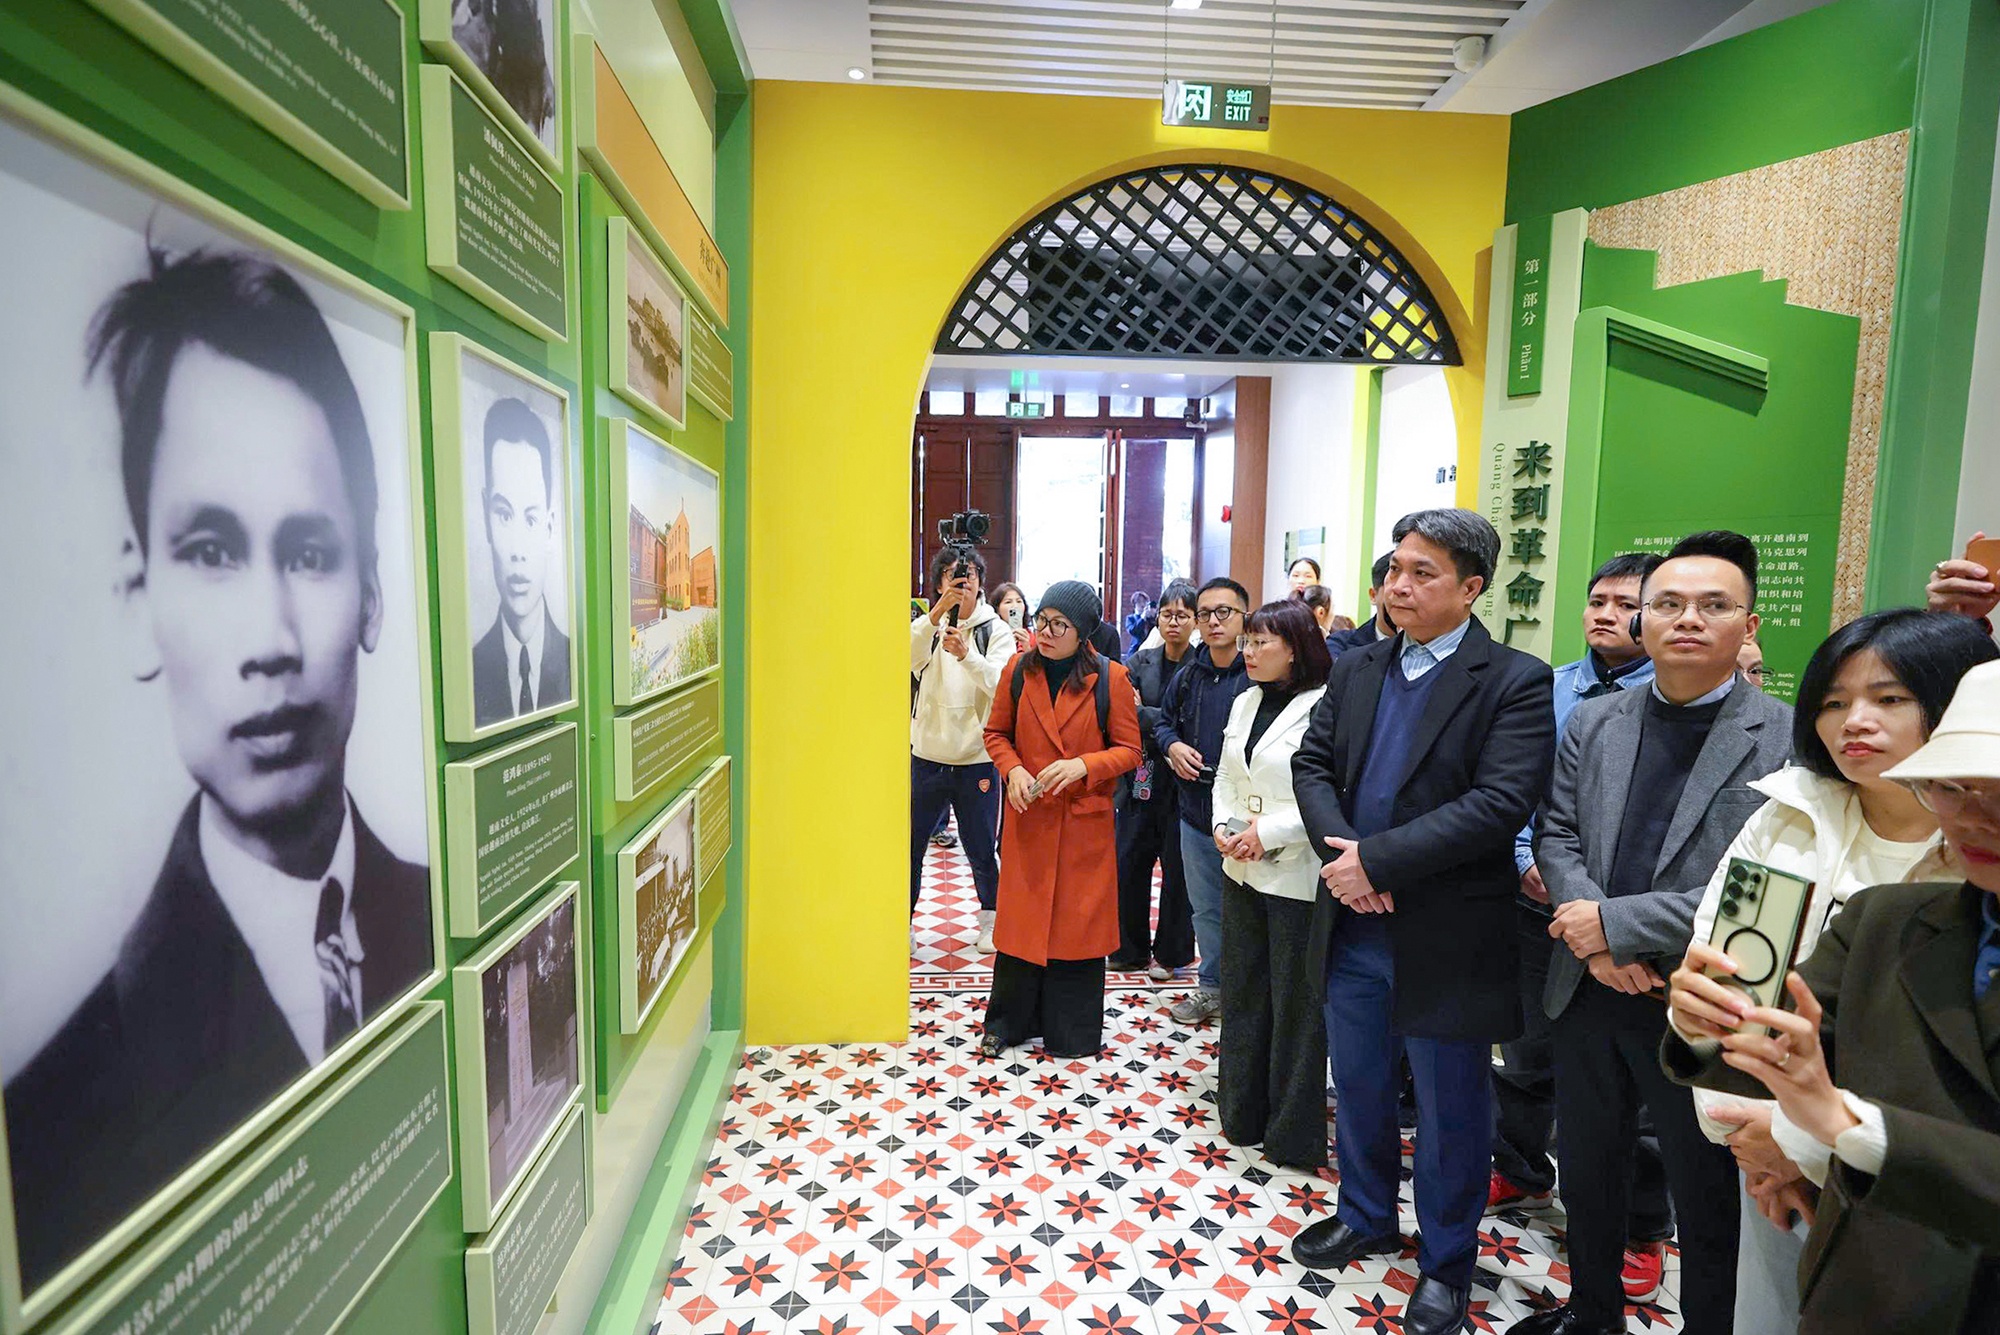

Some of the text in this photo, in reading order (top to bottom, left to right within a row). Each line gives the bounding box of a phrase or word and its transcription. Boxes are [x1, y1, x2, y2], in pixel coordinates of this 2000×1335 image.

[1226, 89, 1253, 105] 安全出口
[1225, 105, 1251, 122] EXIT
[1521, 258, 1540, 327] 第一部分
[1519, 344, 1532, 372] Phần
[1490, 443, 1505, 490] Quảng
[1756, 576, 1804, 585] 同志向共
